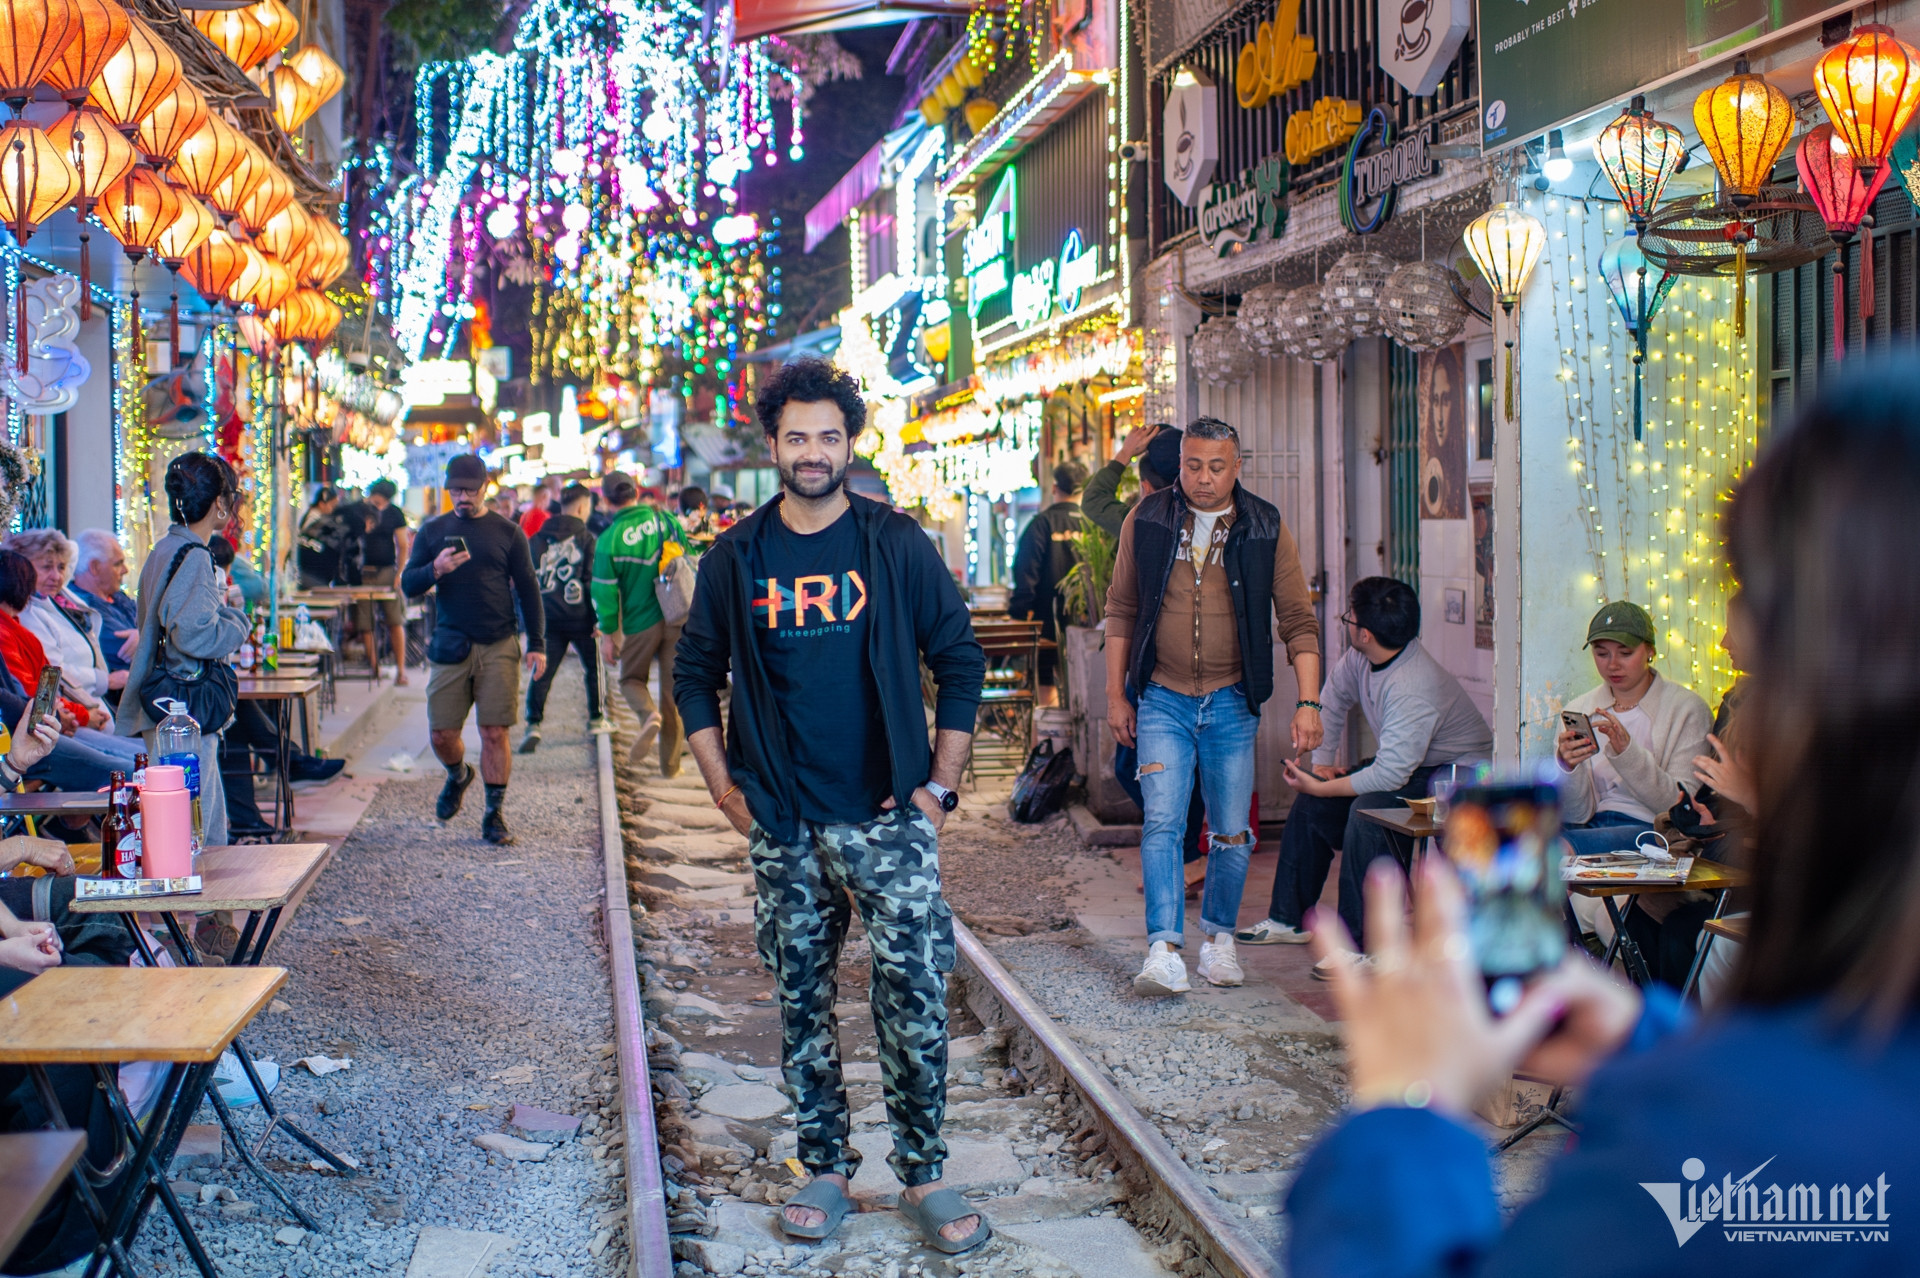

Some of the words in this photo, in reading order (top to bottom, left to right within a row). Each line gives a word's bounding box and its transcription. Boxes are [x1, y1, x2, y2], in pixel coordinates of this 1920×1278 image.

[1495, 27, 1530, 54] PROBABLY
[1532, 21, 1545, 35] THE
[1547, 8, 1565, 27] BEST
[1285, 95, 1362, 165] Coffee
[1354, 122, 1434, 207] TUBORG
[1197, 180, 1259, 256] Carlsberg
[780, 624, 850, 638] #keepgoing
